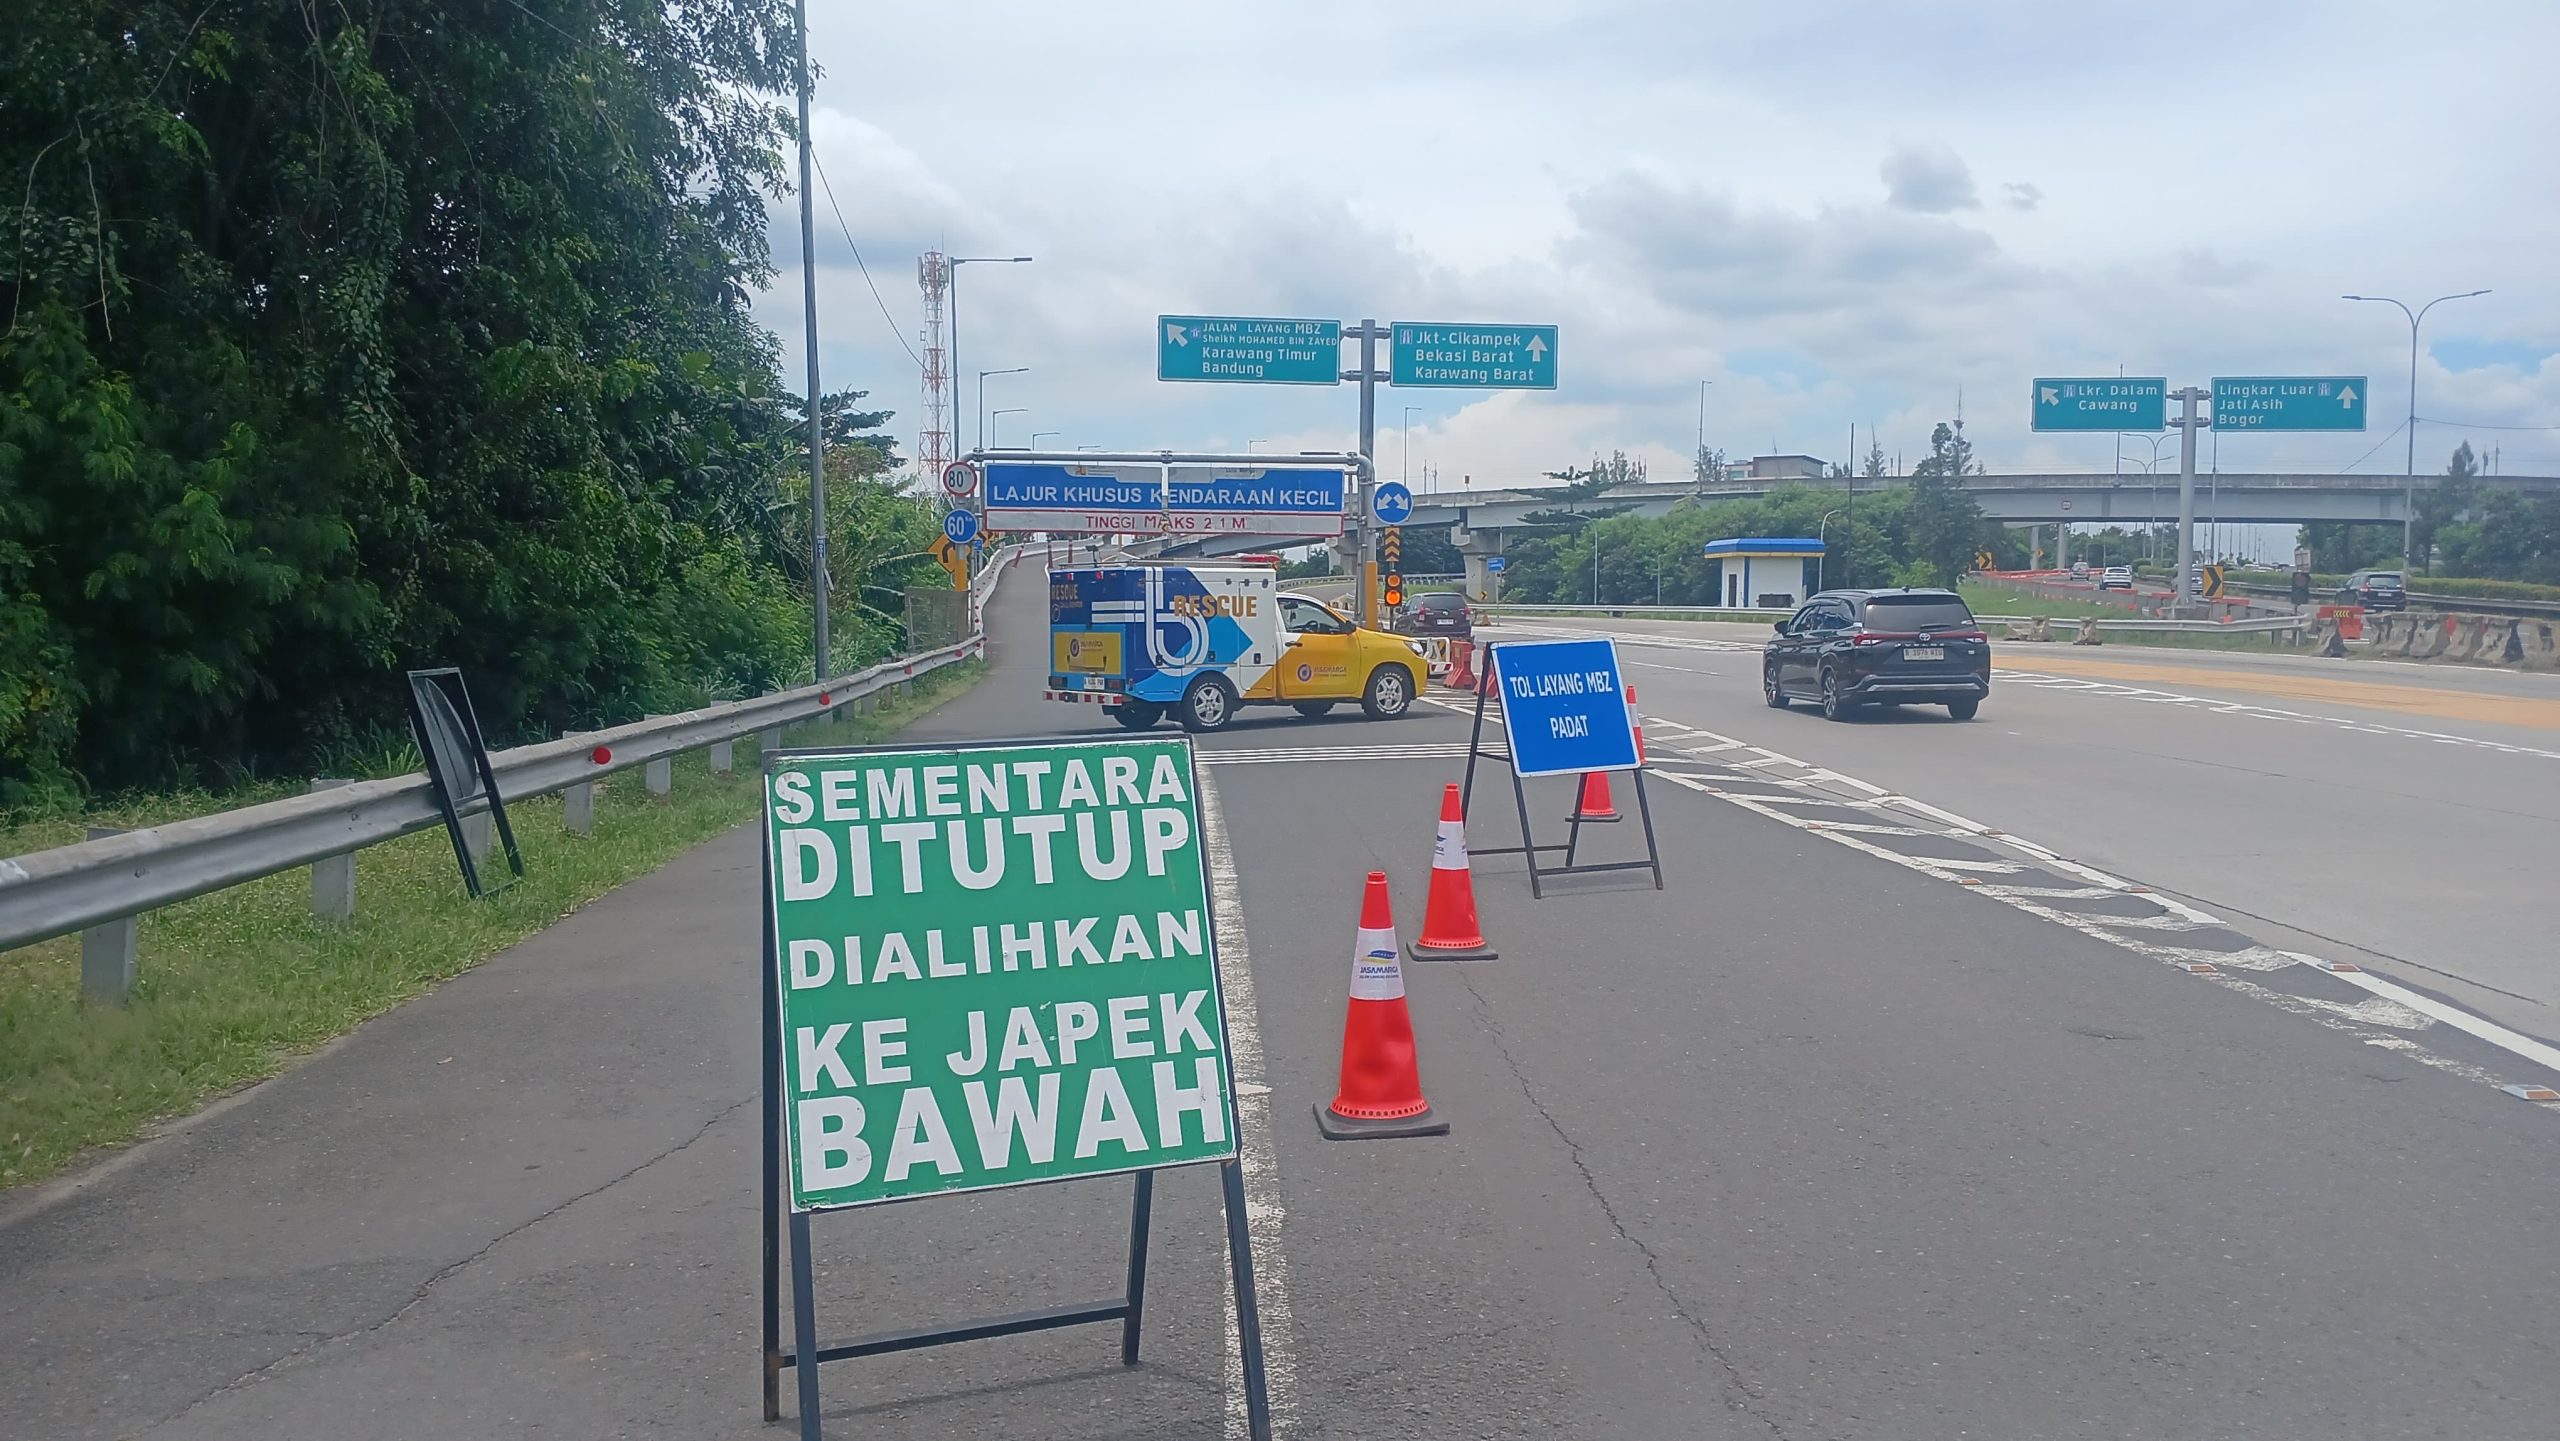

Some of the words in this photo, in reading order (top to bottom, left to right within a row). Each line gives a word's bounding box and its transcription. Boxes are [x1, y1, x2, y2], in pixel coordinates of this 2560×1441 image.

[1202, 323, 1237, 333] JALAN
[1247, 323, 1291, 334] LAYANG
[1294, 323, 1322, 335] MBZ
[1202, 334, 1235, 344] Sheikh
[1238, 335, 1285, 345] MOHAMED
[1288, 336, 1305, 346] BIN
[1308, 337, 1337, 346] ZAYED
[1202, 346, 1273, 363] Karawang
[1277, 348, 1317, 361] Timur
[1415, 349, 1467, 362] Bekasi
[1471, 350, 1514, 363] Barat
[1202, 362, 1264, 378] Bandung
[1415, 366, 1488, 383] Karawang
[1493, 368, 1534, 381] Barat
[2078, 385, 2104, 396] Lkr.
[2109, 384, 2158, 396] Dalam
[2219, 384, 2277, 398] Lingkar
[2281, 384, 2314, 396] Luar
[2078, 399, 2138, 413] Cawang
[2219, 398, 2248, 411] Jati
[2250, 398, 2284, 411] Asih
[2218, 413, 2264, 426] Bogor
[948, 470, 964, 488] 80
[993, 485, 1058, 502] LAJUR
[1063, 486, 1142, 503] KHUSUS
[1150, 487, 1274, 505] KENDARAAN
[1279, 489, 1336, 506] KECIL
[947, 515, 965, 536] 60
[1085, 515, 1136, 530] TINGGI
[1232, 517, 1246, 530] M
[1173, 595, 1258, 618] RESCUE
[1509, 676, 1535, 699] TOL
[1536, 673, 1584, 697] LAYANG
[1586, 671, 1613, 694] MBZ
[1550, 715, 1589, 739] PADAT
[774, 754, 1188, 824] SEMENTARA
[779, 807, 1190, 902] DITUTUP
[788, 909, 1204, 990] DIALIHKAN
[796, 1017, 914, 1093] KE
[946, 989, 1217, 1077] JAPEK
[797, 1056, 1227, 1193] BAWAH
